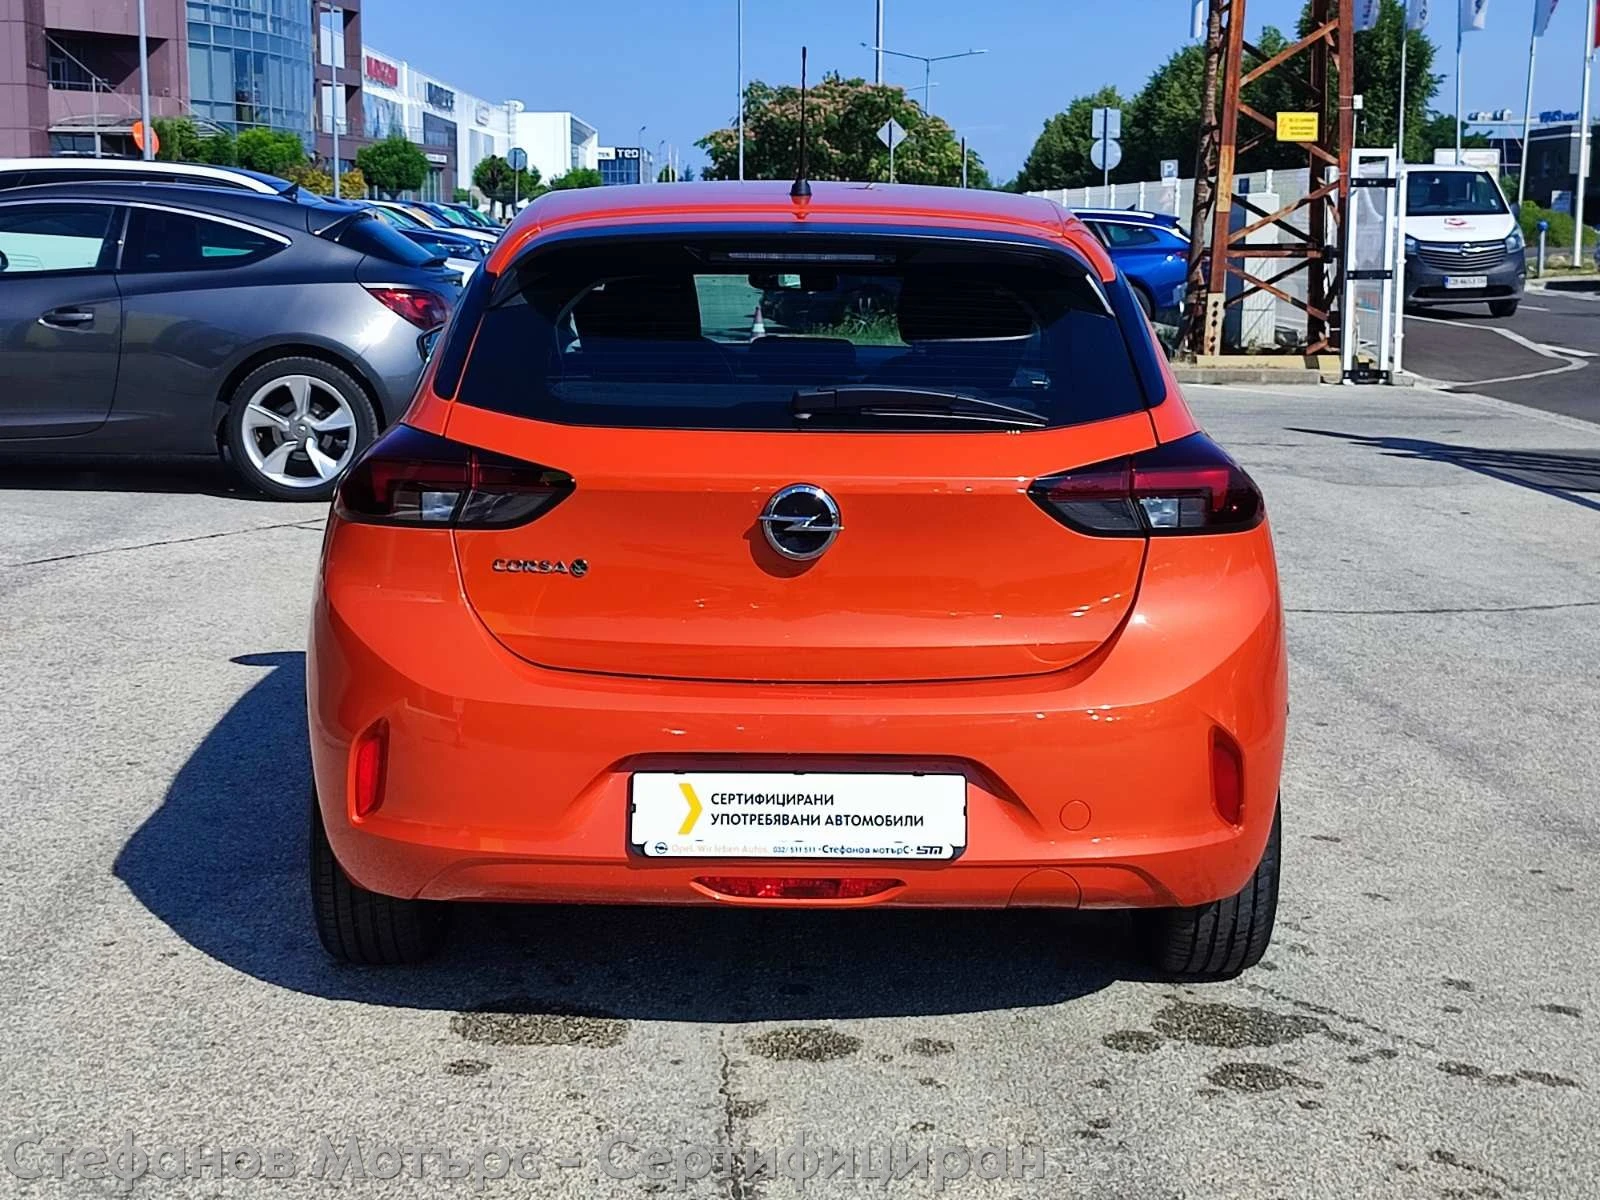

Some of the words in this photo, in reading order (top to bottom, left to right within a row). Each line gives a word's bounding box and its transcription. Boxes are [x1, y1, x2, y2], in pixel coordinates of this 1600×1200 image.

[492, 559, 568, 573] CORSA
[711, 793, 834, 807] СЕРТИФИЦИРАНИ
[711, 813, 821, 825] УПОТРЕБЯВАНИ
[825, 814, 924, 827] АВТОМОБИЛИ
